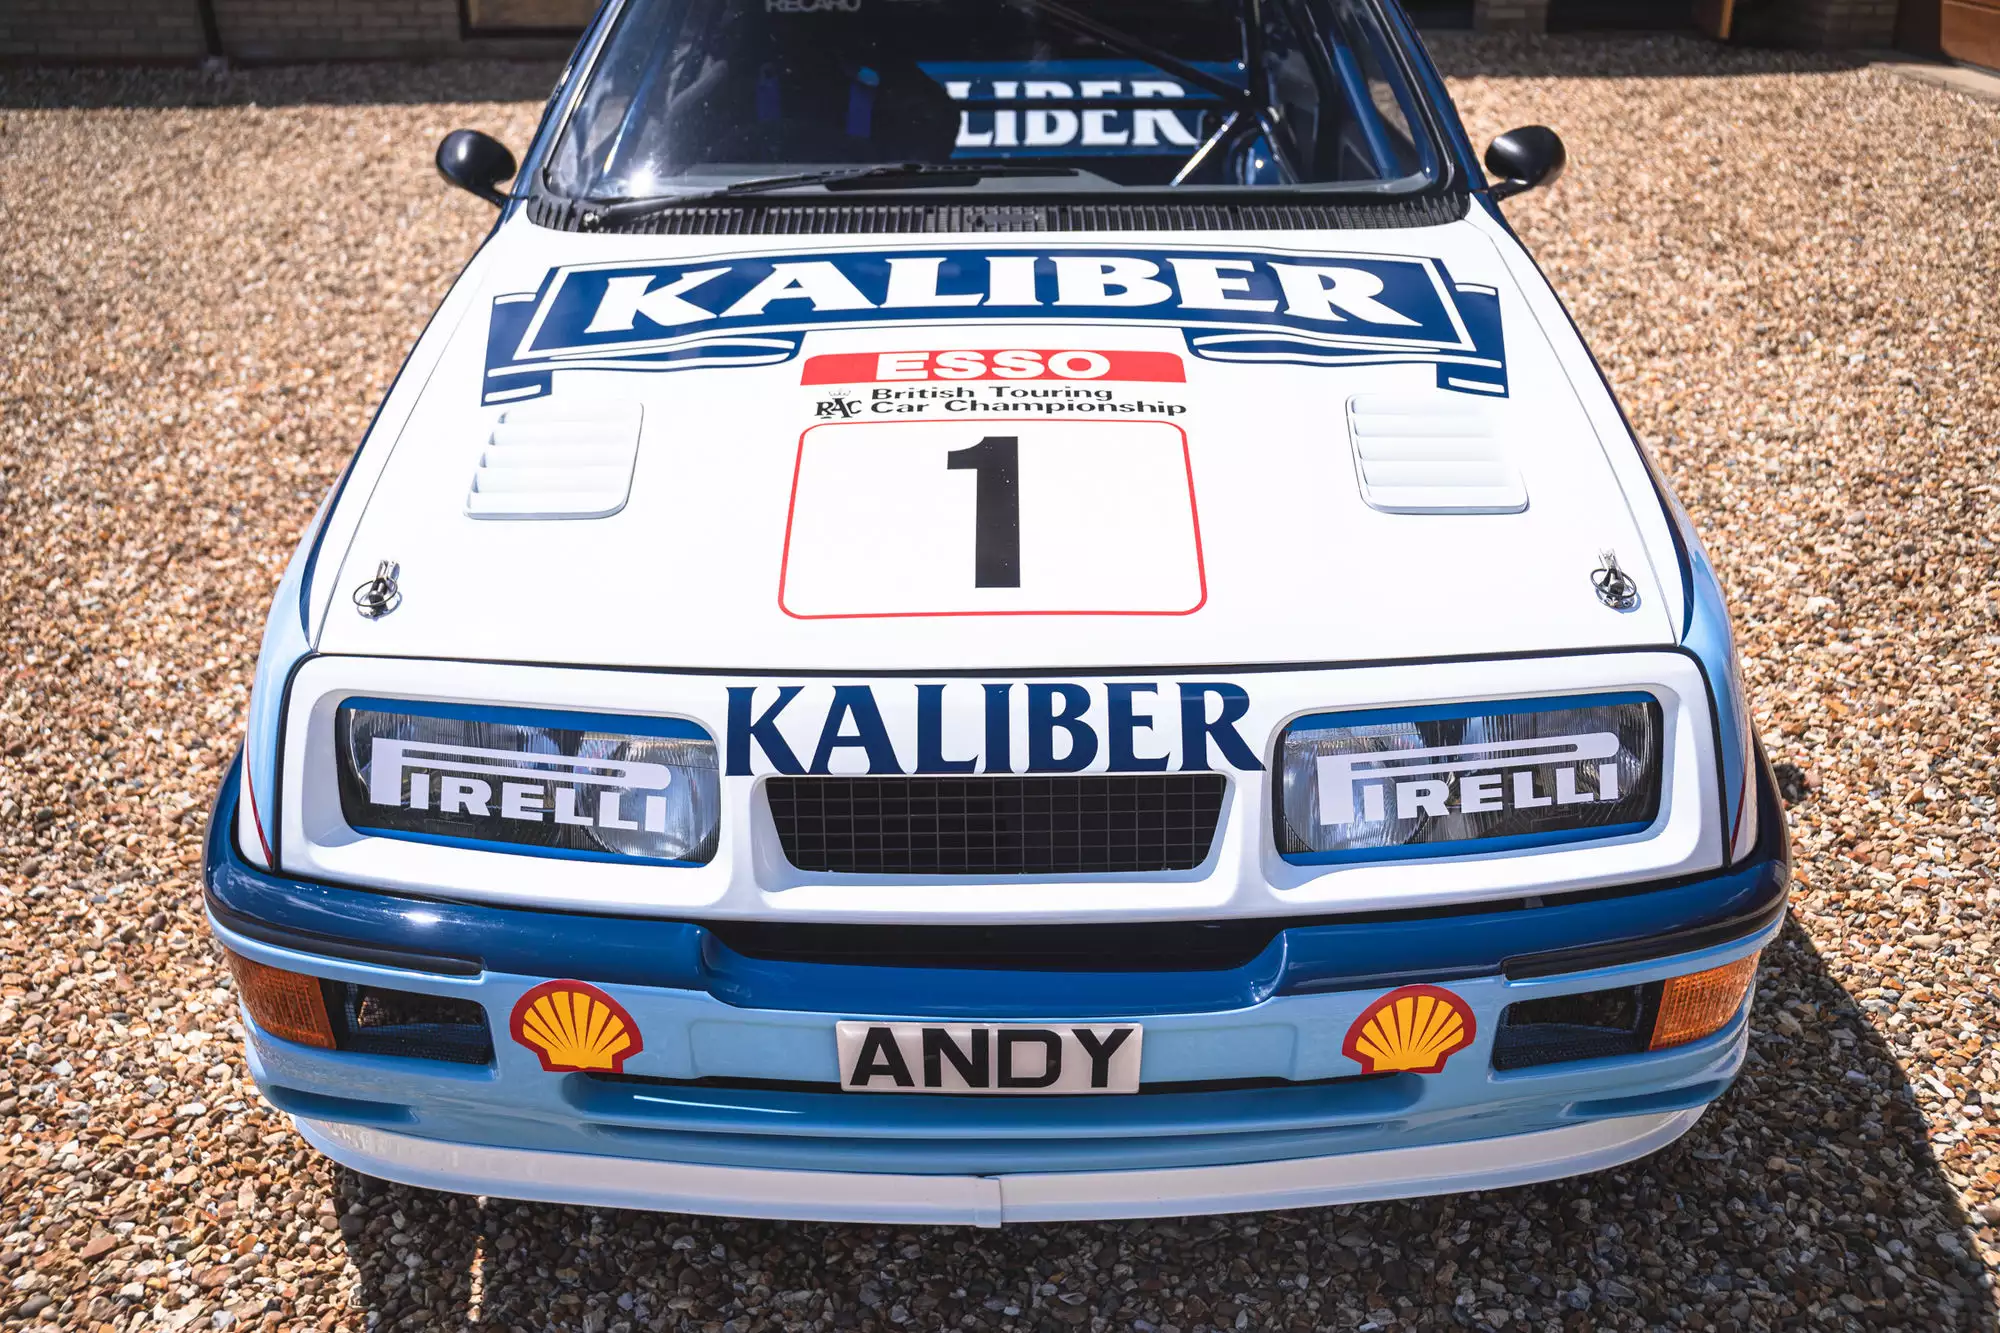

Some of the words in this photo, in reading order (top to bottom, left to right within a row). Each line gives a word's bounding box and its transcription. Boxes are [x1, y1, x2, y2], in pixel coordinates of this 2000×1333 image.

[585, 256, 1423, 334] KALIBER
[872, 386, 975, 400] British
[988, 385, 1113, 401] Touring
[875, 350, 1111, 380] ESSO
[814, 397, 862, 419] RAC
[871, 401, 930, 413] Car
[944, 399, 1187, 417] Championship
[947, 436, 1021, 588] 1
[724, 682, 1266, 777] KALIBER
[370, 737, 672, 833] PIRELLI
[1316, 732, 1619, 826] PIRELLI
[850, 1027, 1134, 1088] ANDY
